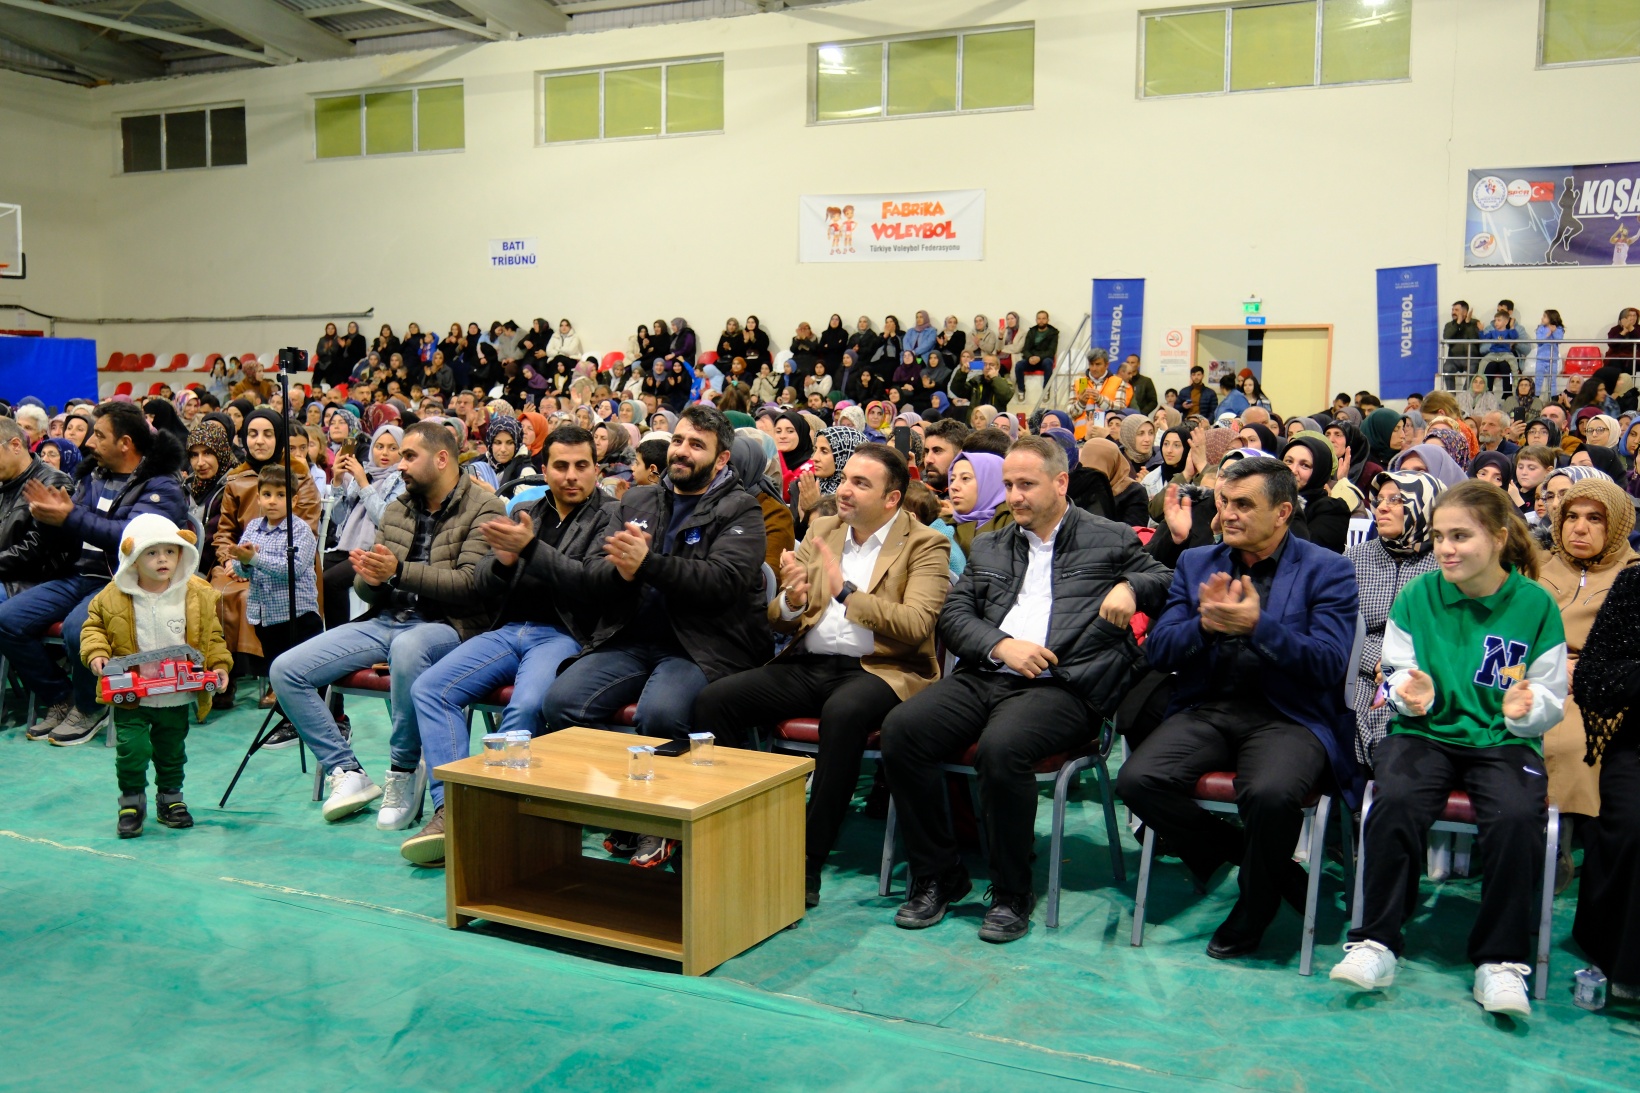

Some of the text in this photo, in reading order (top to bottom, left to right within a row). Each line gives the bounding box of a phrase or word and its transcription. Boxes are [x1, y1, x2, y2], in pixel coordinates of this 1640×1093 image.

[871, 220, 956, 241] VOLEYBOL
[502, 241, 525, 251] BATI
[870, 244, 960, 253] Türkiye Voleybol Federasyonu
[491, 253, 536, 266] TRİBÜNÜ
[1109, 304, 1123, 363] VOLEYBOL
[1401, 294, 1413, 358] VOLEYBOL
